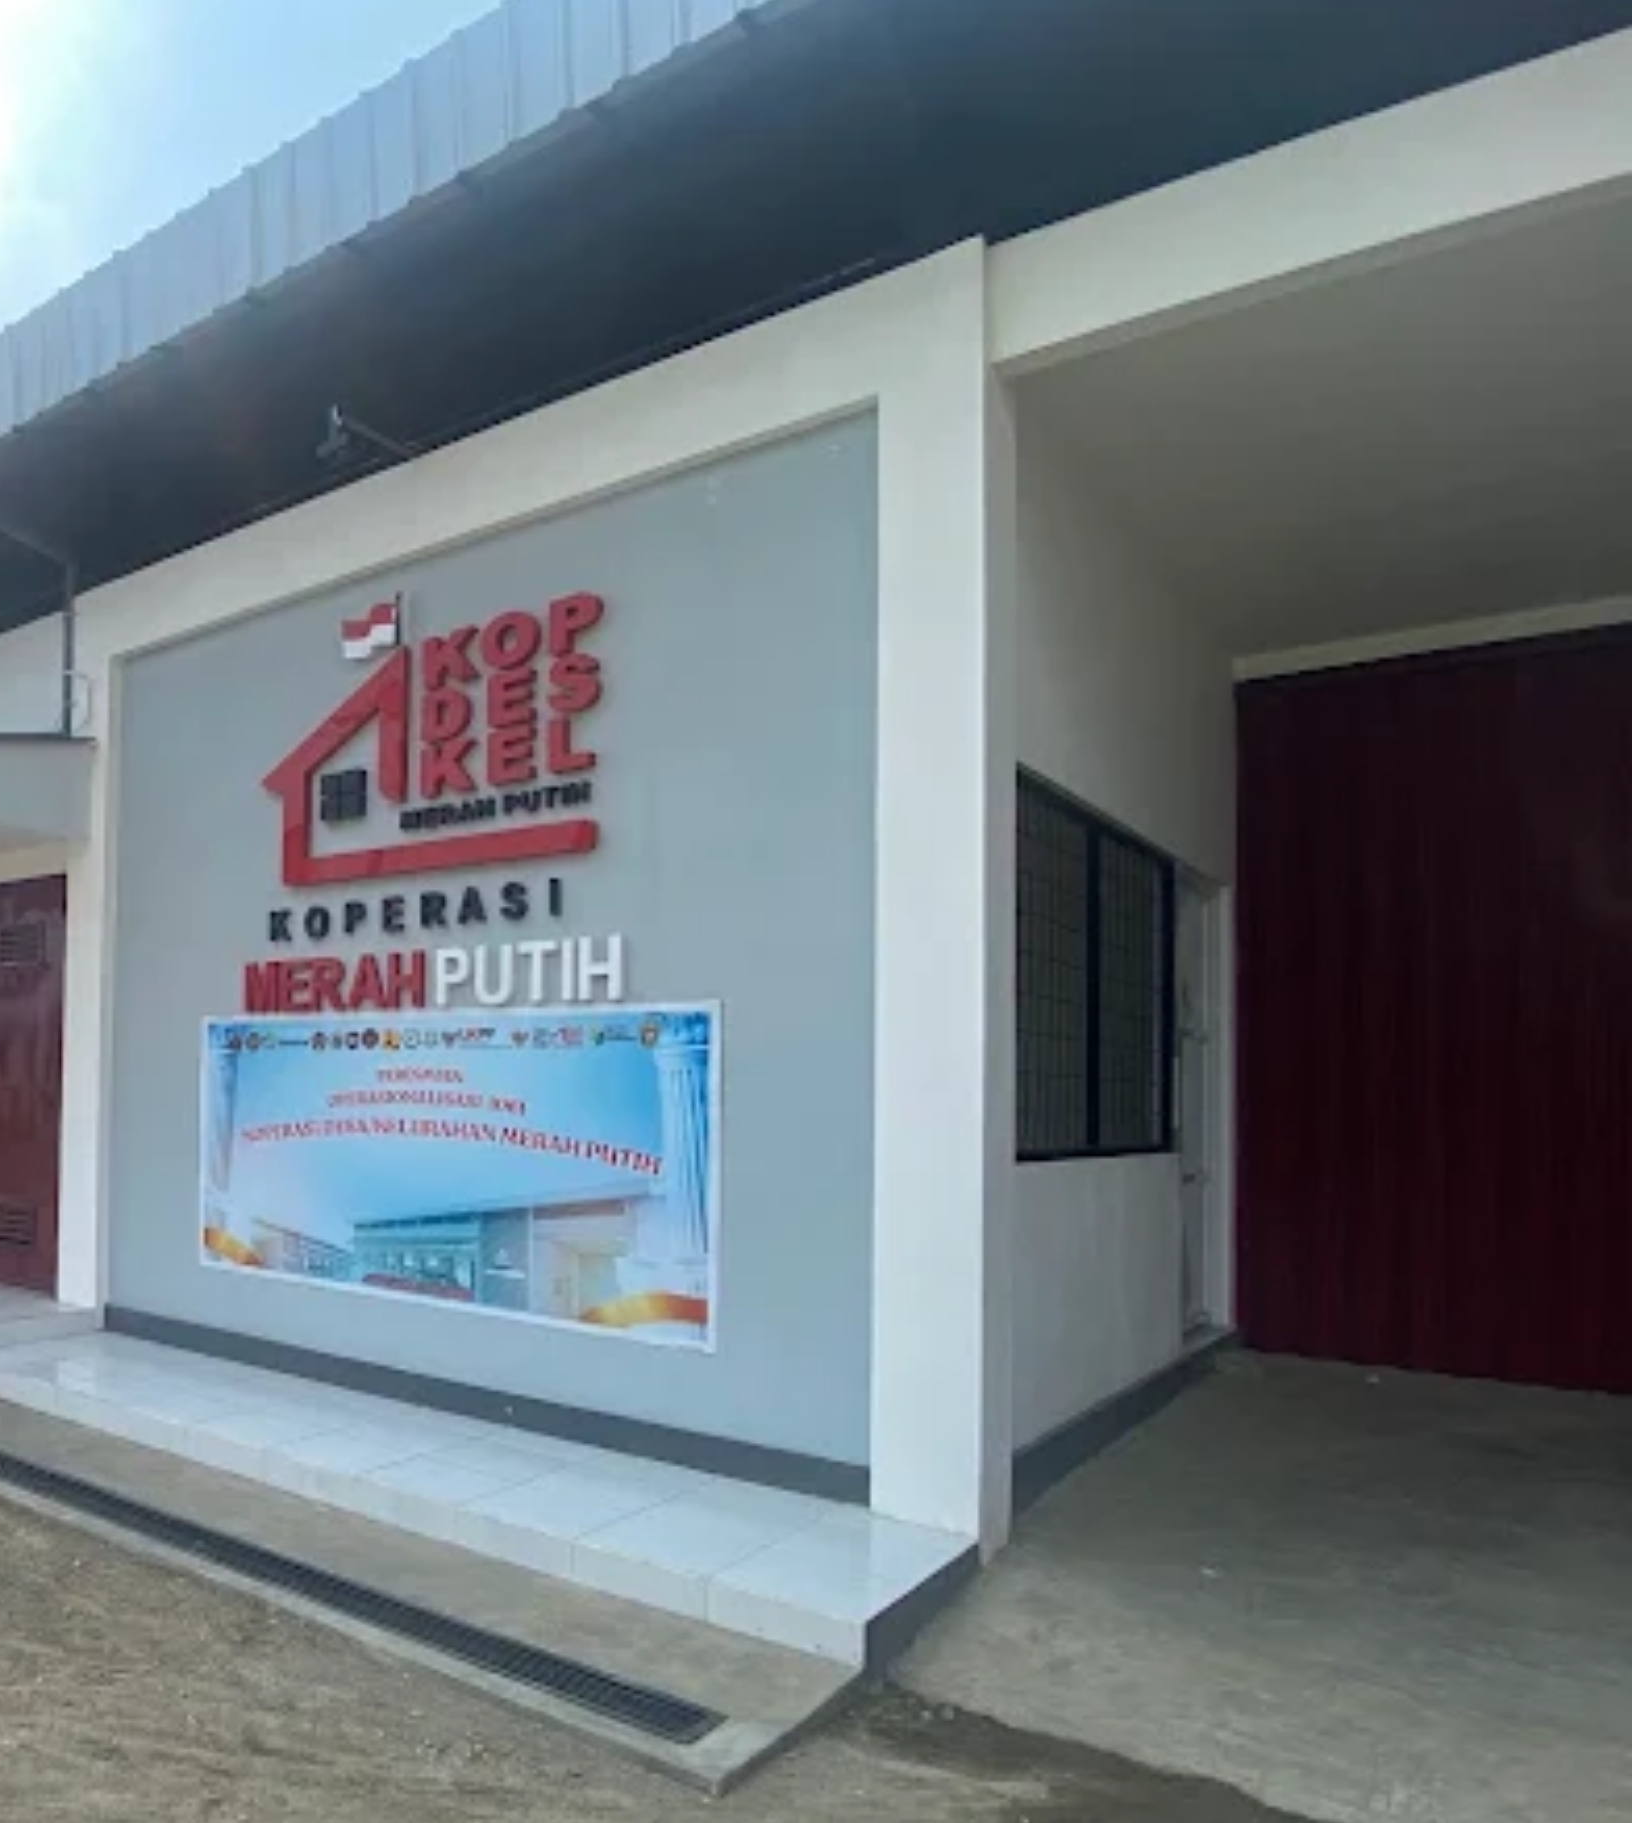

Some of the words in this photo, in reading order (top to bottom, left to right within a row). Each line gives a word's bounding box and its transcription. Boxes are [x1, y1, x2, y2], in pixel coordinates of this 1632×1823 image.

[420, 592, 606, 693] KOP
[421, 653, 603, 745] DES
[420, 718, 598, 800] KEL
[400, 797, 496, 830] MERAH
[503, 781, 592, 815] PUTIH
[268, 877, 564, 944] KOPERASI
[244, 949, 427, 1014] MERAH
[435, 933, 623, 1006] PUTIH
[501, 1126, 580, 1158] MERAH
[586, 1140, 662, 1176] PUTIH
